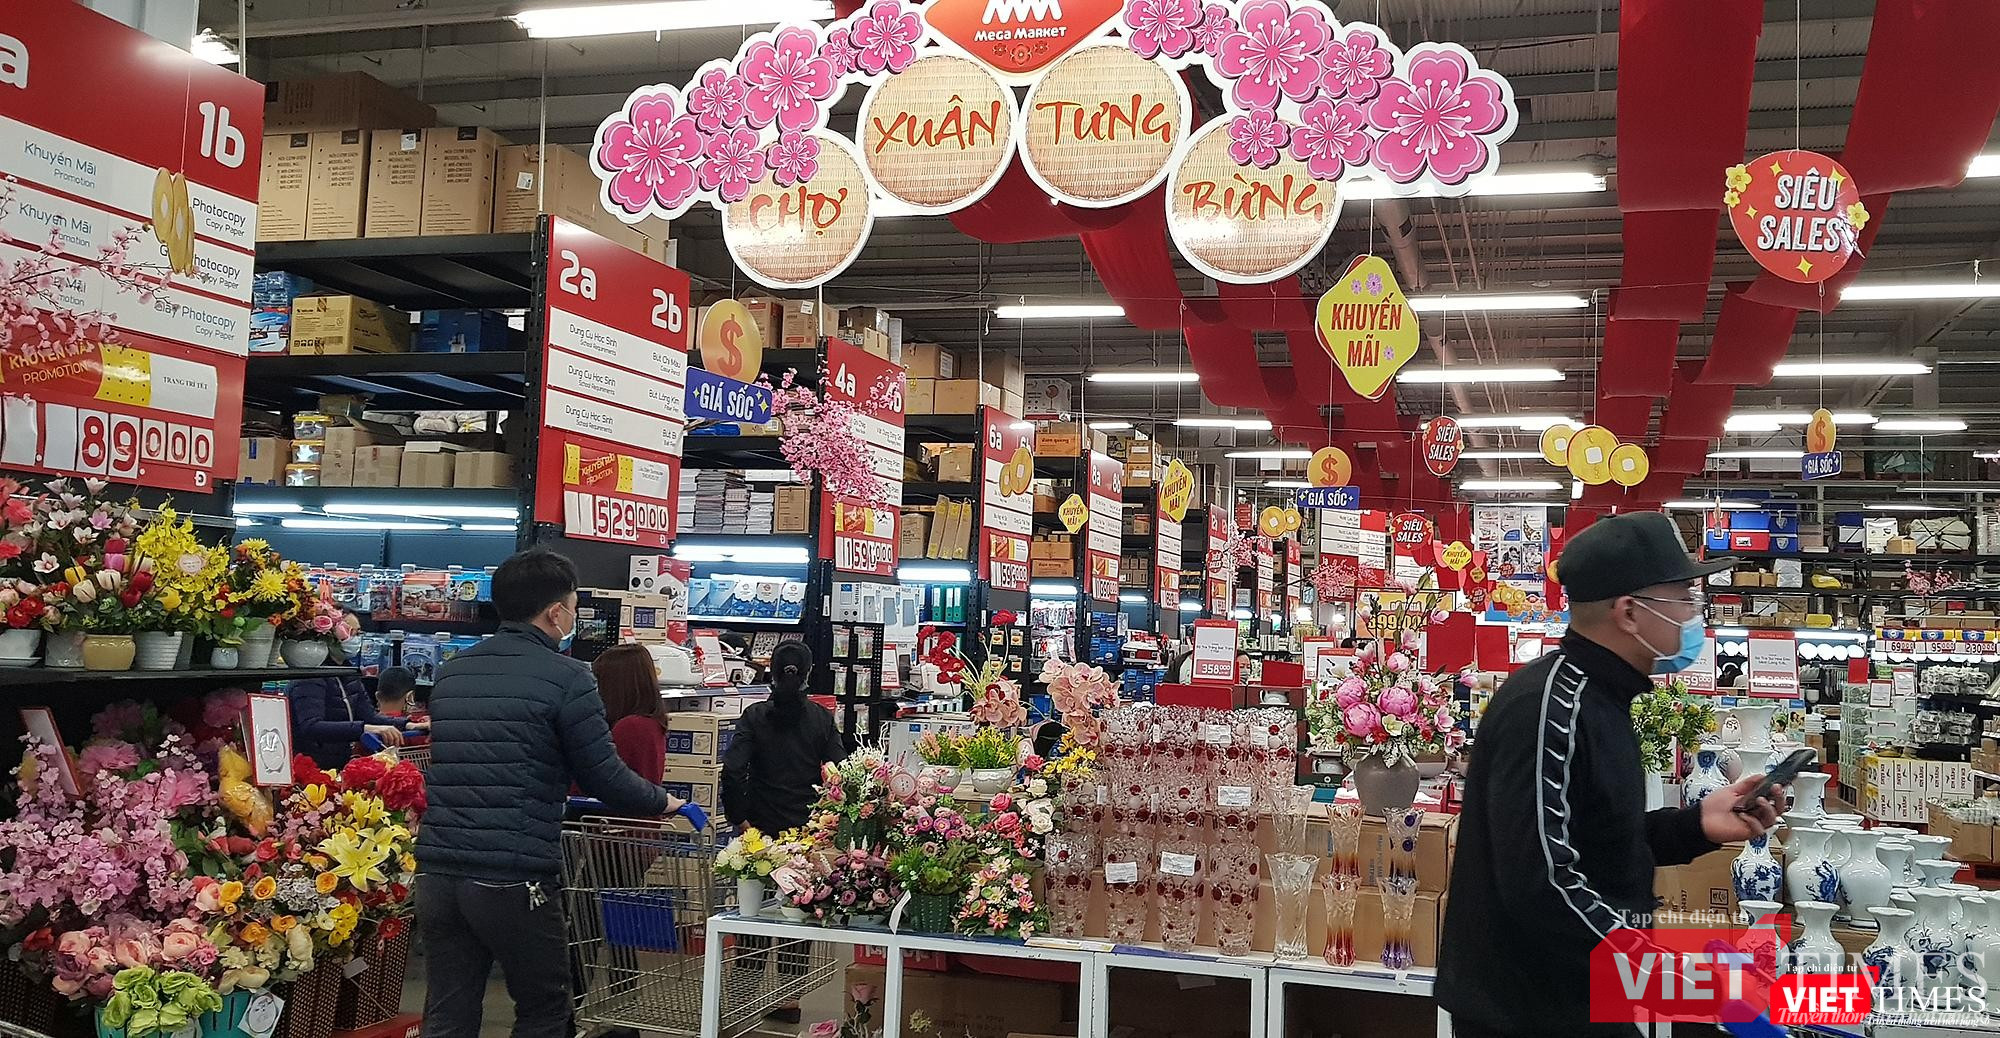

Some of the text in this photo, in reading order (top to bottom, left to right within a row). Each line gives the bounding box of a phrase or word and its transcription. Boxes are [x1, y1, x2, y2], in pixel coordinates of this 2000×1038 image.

[199, 101, 245, 169] 1b
[874, 94, 1001, 154] XUÂN
[1036, 94, 1171, 145] TƯNG
[53, 169, 96, 189] Promotion
[1774, 167, 1838, 211] SIÊU
[193, 197, 247, 228] Photocopy
[750, 185, 848, 236] CHỢ
[1183, 173, 1324, 221] BỪNG
[205, 217, 224, 232] Copy
[1757, 215, 1841, 256] SALES
[193, 254, 241, 279] hotocopy
[559, 249, 596, 302] 2a
[182, 305, 236, 331] Photocopy
[651, 288, 682, 333] 2b
[1331, 292, 1402, 331] KHUYẾN
[195, 325, 213, 338] Copy
[1347, 333, 1380, 367] MÃI
[22, 360, 89, 385] PROMOTION
[834, 362, 857, 399] 4a
[699, 382, 755, 422] GIÁ SỐC
[988, 423, 1003, 451] 6a
[1435, 423, 1457, 443] SIÊU
[1428, 443, 1456, 461] SALES
[1163, 471, 1187, 499] KHUYẾN
[1308, 487, 1348, 506] GIÁ SỐC
[1396, 531, 1424, 543] SALES
[1402, 519, 1423, 532] SIÊU
